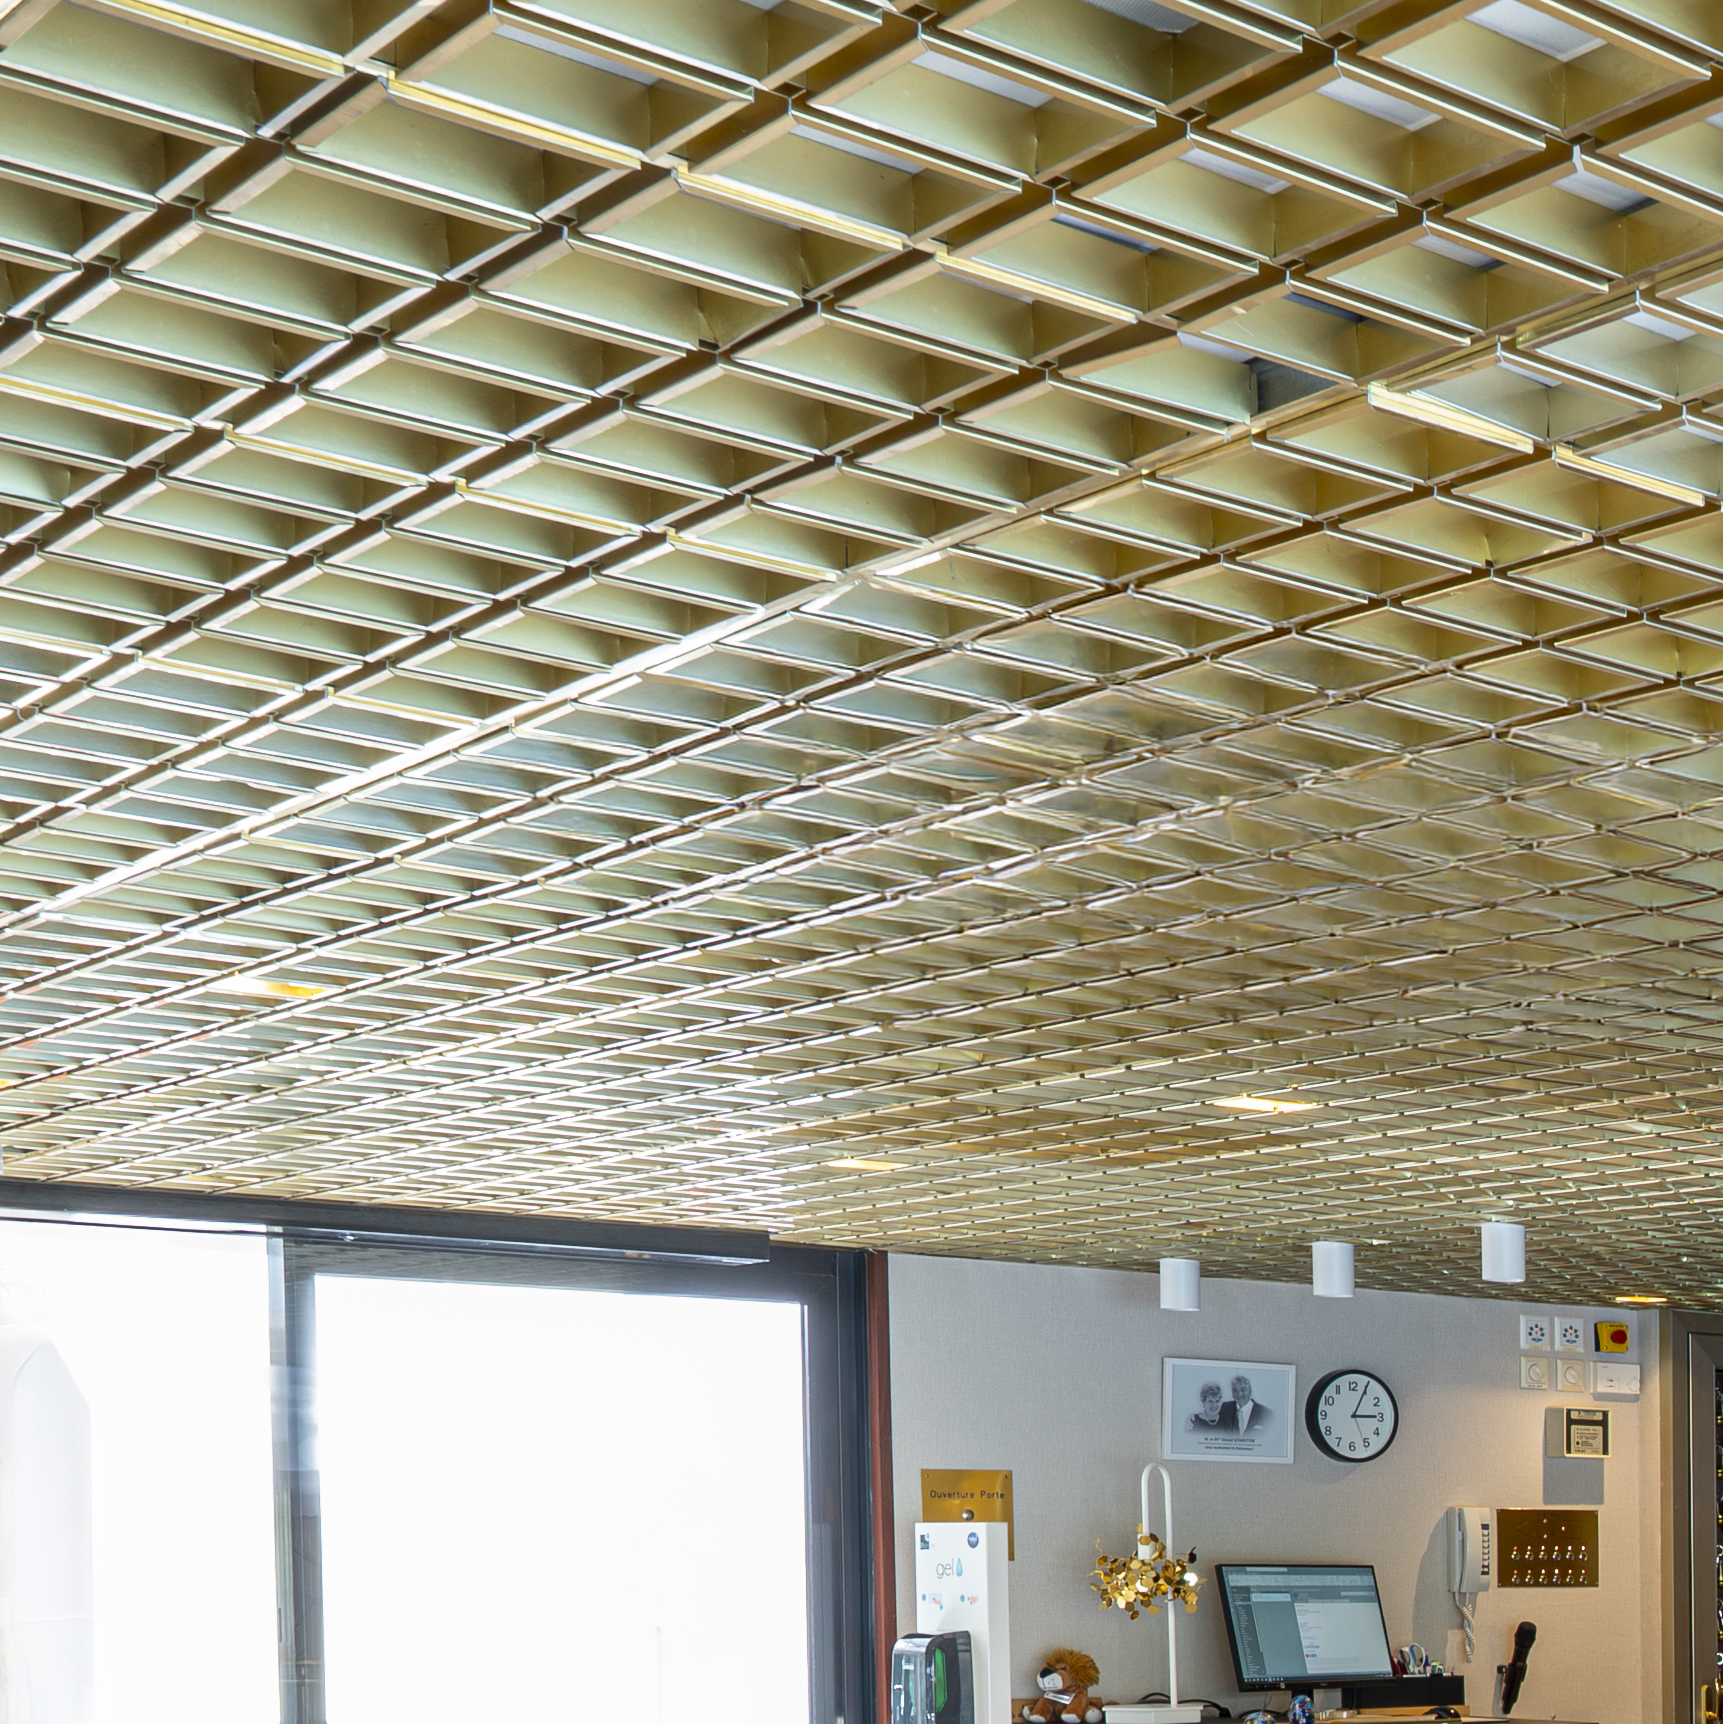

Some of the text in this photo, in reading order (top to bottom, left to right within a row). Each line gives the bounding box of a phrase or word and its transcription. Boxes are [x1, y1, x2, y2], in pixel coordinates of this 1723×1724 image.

[1335, 1384, 1341, 1395] 11
[1348, 1380, 1358, 1392] 12
[1324, 1395, 1335, 1406] 10
[1373, 1396, 1380, 1407] 2
[1320, 1410, 1328, 1420] 9
[1377, 1412, 1384, 1422] 3
[1324, 1425, 1332, 1436] 8
[1373, 1426, 1380, 1437] 4
[1335, 1437, 1342, 1447] 7
[1348, 1441, 1356, 1452] 6
[1363, 1437, 1370, 1448] 5
[930, 1489, 1006, 1500] Ouverture Porte
[936, 1558, 954, 1579] gel
